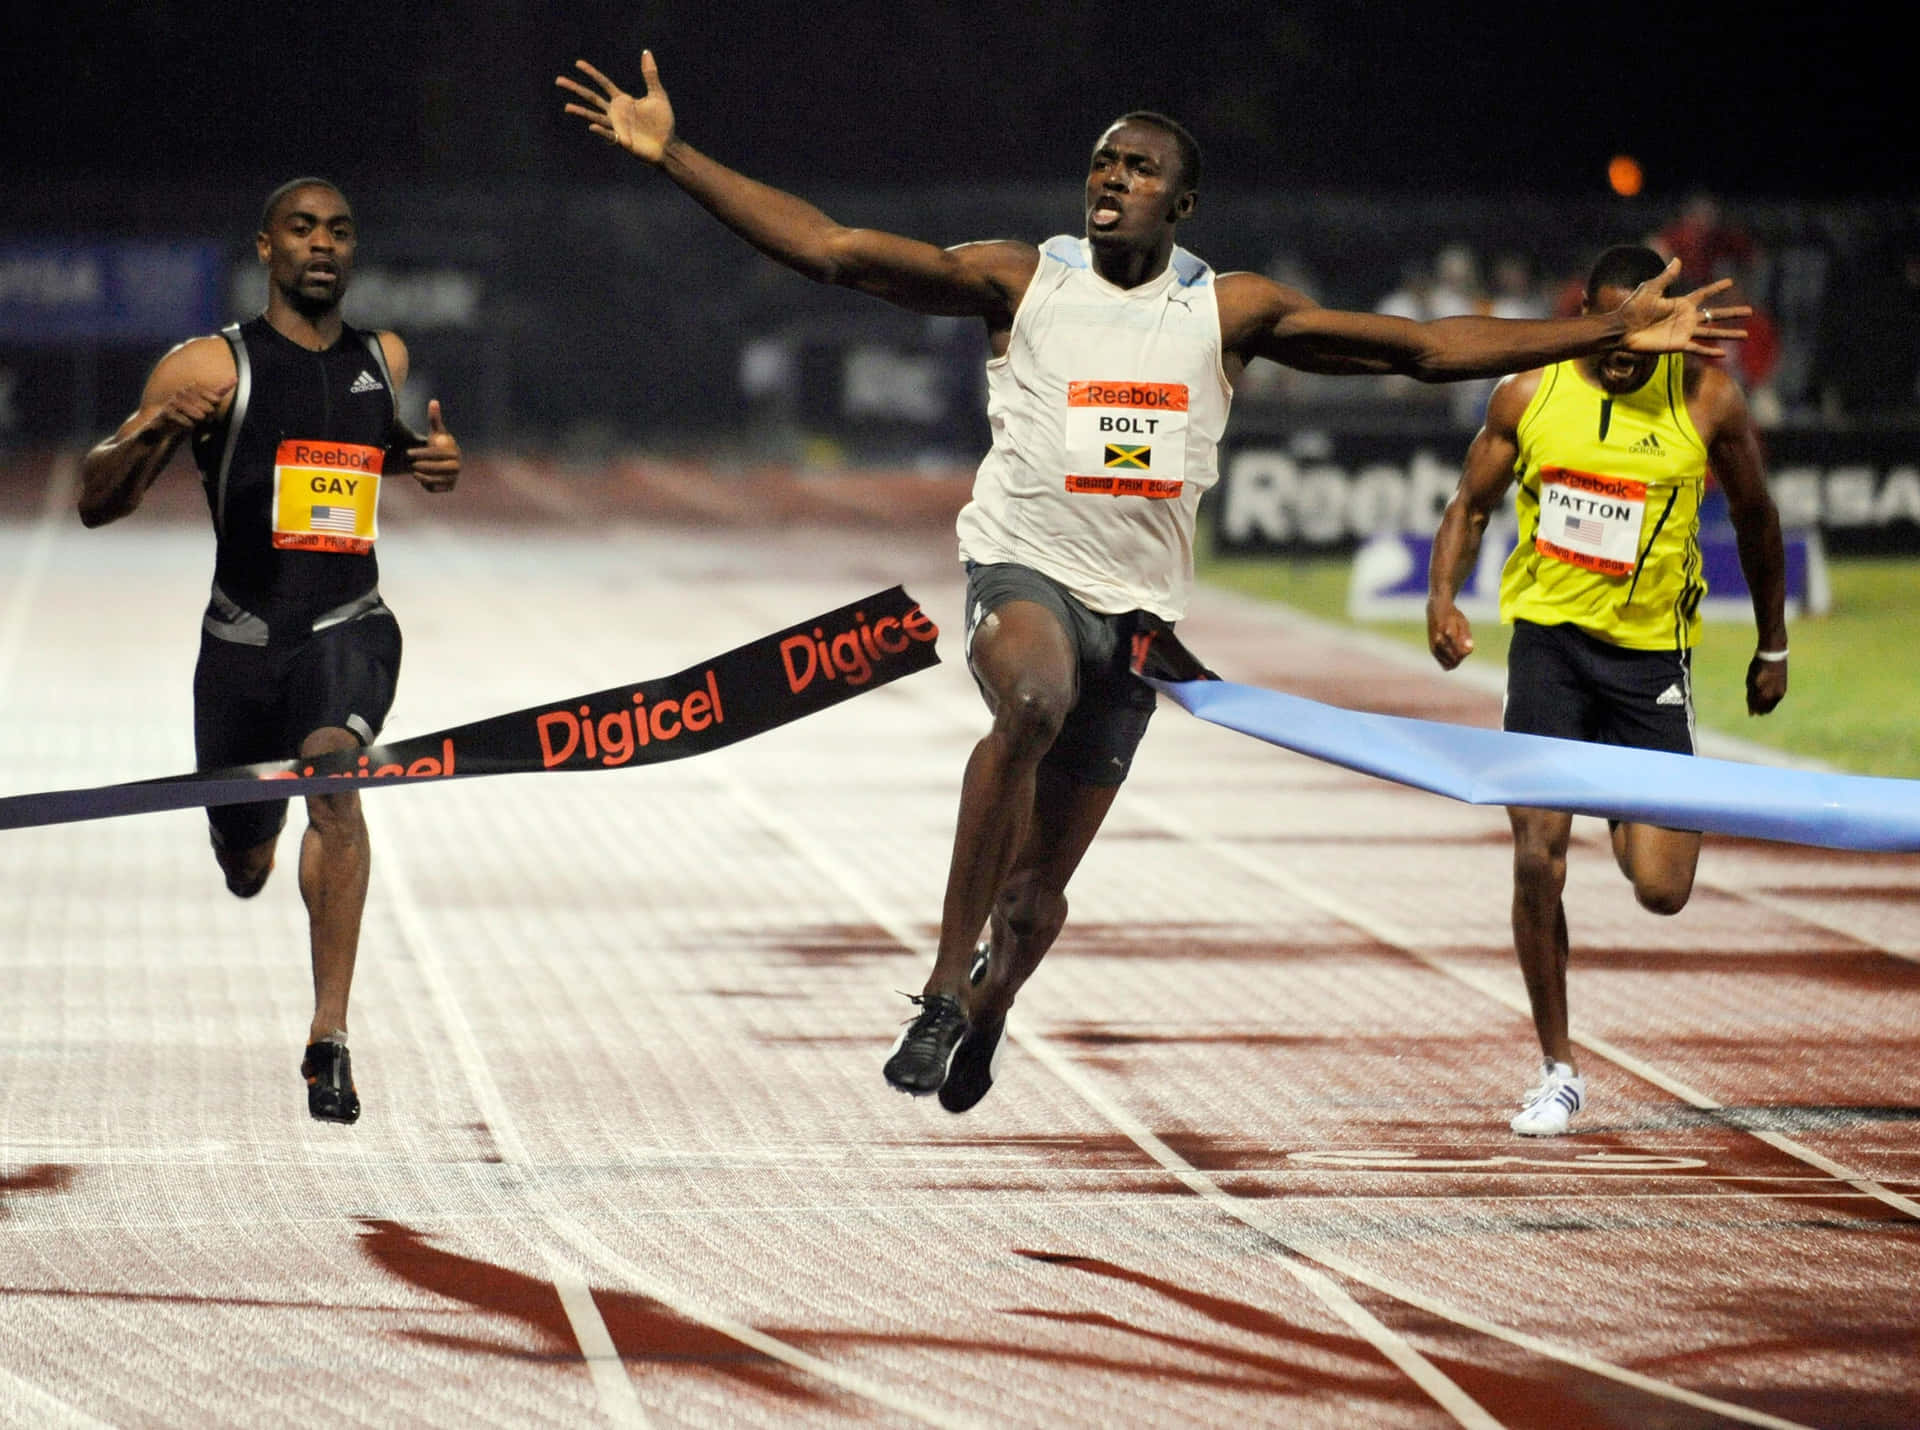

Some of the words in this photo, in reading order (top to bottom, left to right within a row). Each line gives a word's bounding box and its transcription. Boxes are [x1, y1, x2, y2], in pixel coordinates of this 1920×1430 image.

[1087, 386, 1171, 406] Reebok
[1100, 416, 1159, 434] BOLT
[295, 446, 371, 470] Reebok
[310, 476, 358, 496] GAY
[1557, 468, 1629, 498] Reebok
[1548, 489, 1630, 522] PATTON
[780, 603, 939, 694] Digice
[536, 670, 724, 768] Digicel
